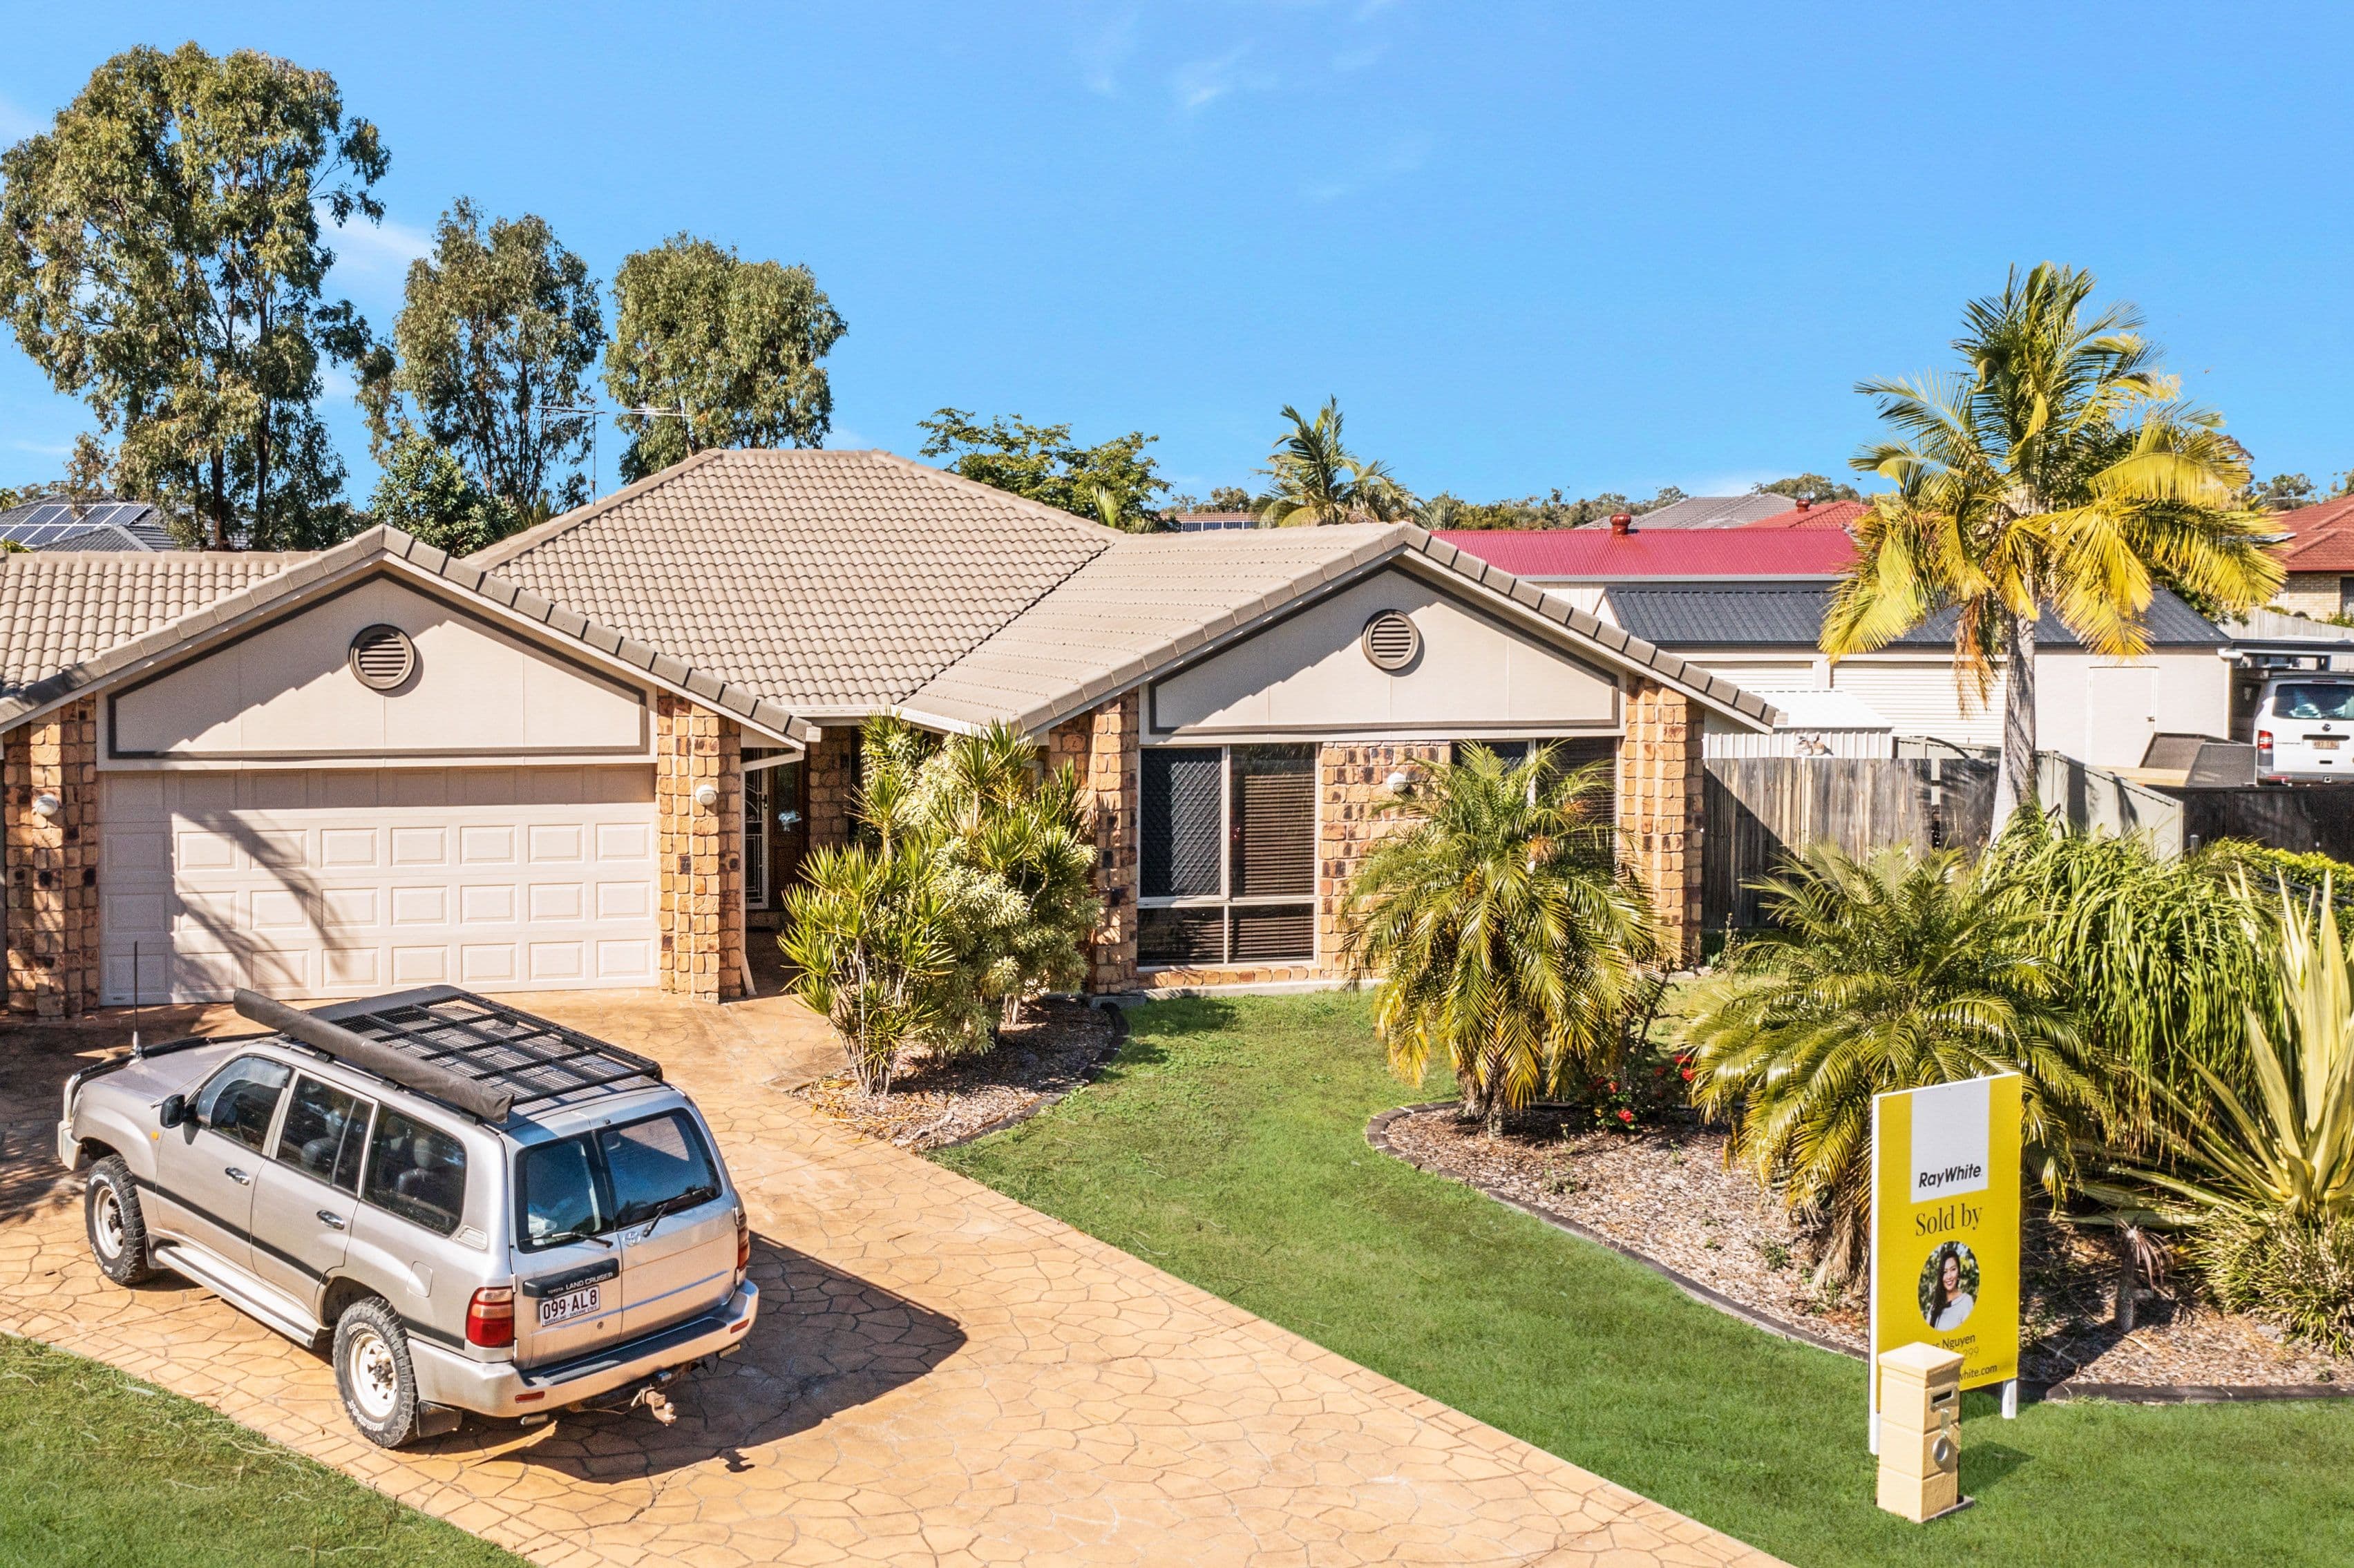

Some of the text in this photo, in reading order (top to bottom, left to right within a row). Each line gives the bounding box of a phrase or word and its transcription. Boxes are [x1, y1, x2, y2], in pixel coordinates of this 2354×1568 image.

[1916, 1203, 1983, 1236] Sold by
[565, 1280, 584, 1291] LAND
[585, 1272, 614, 1285] CRUISER
[1942, 1334, 1975, 1350] Nguyen
